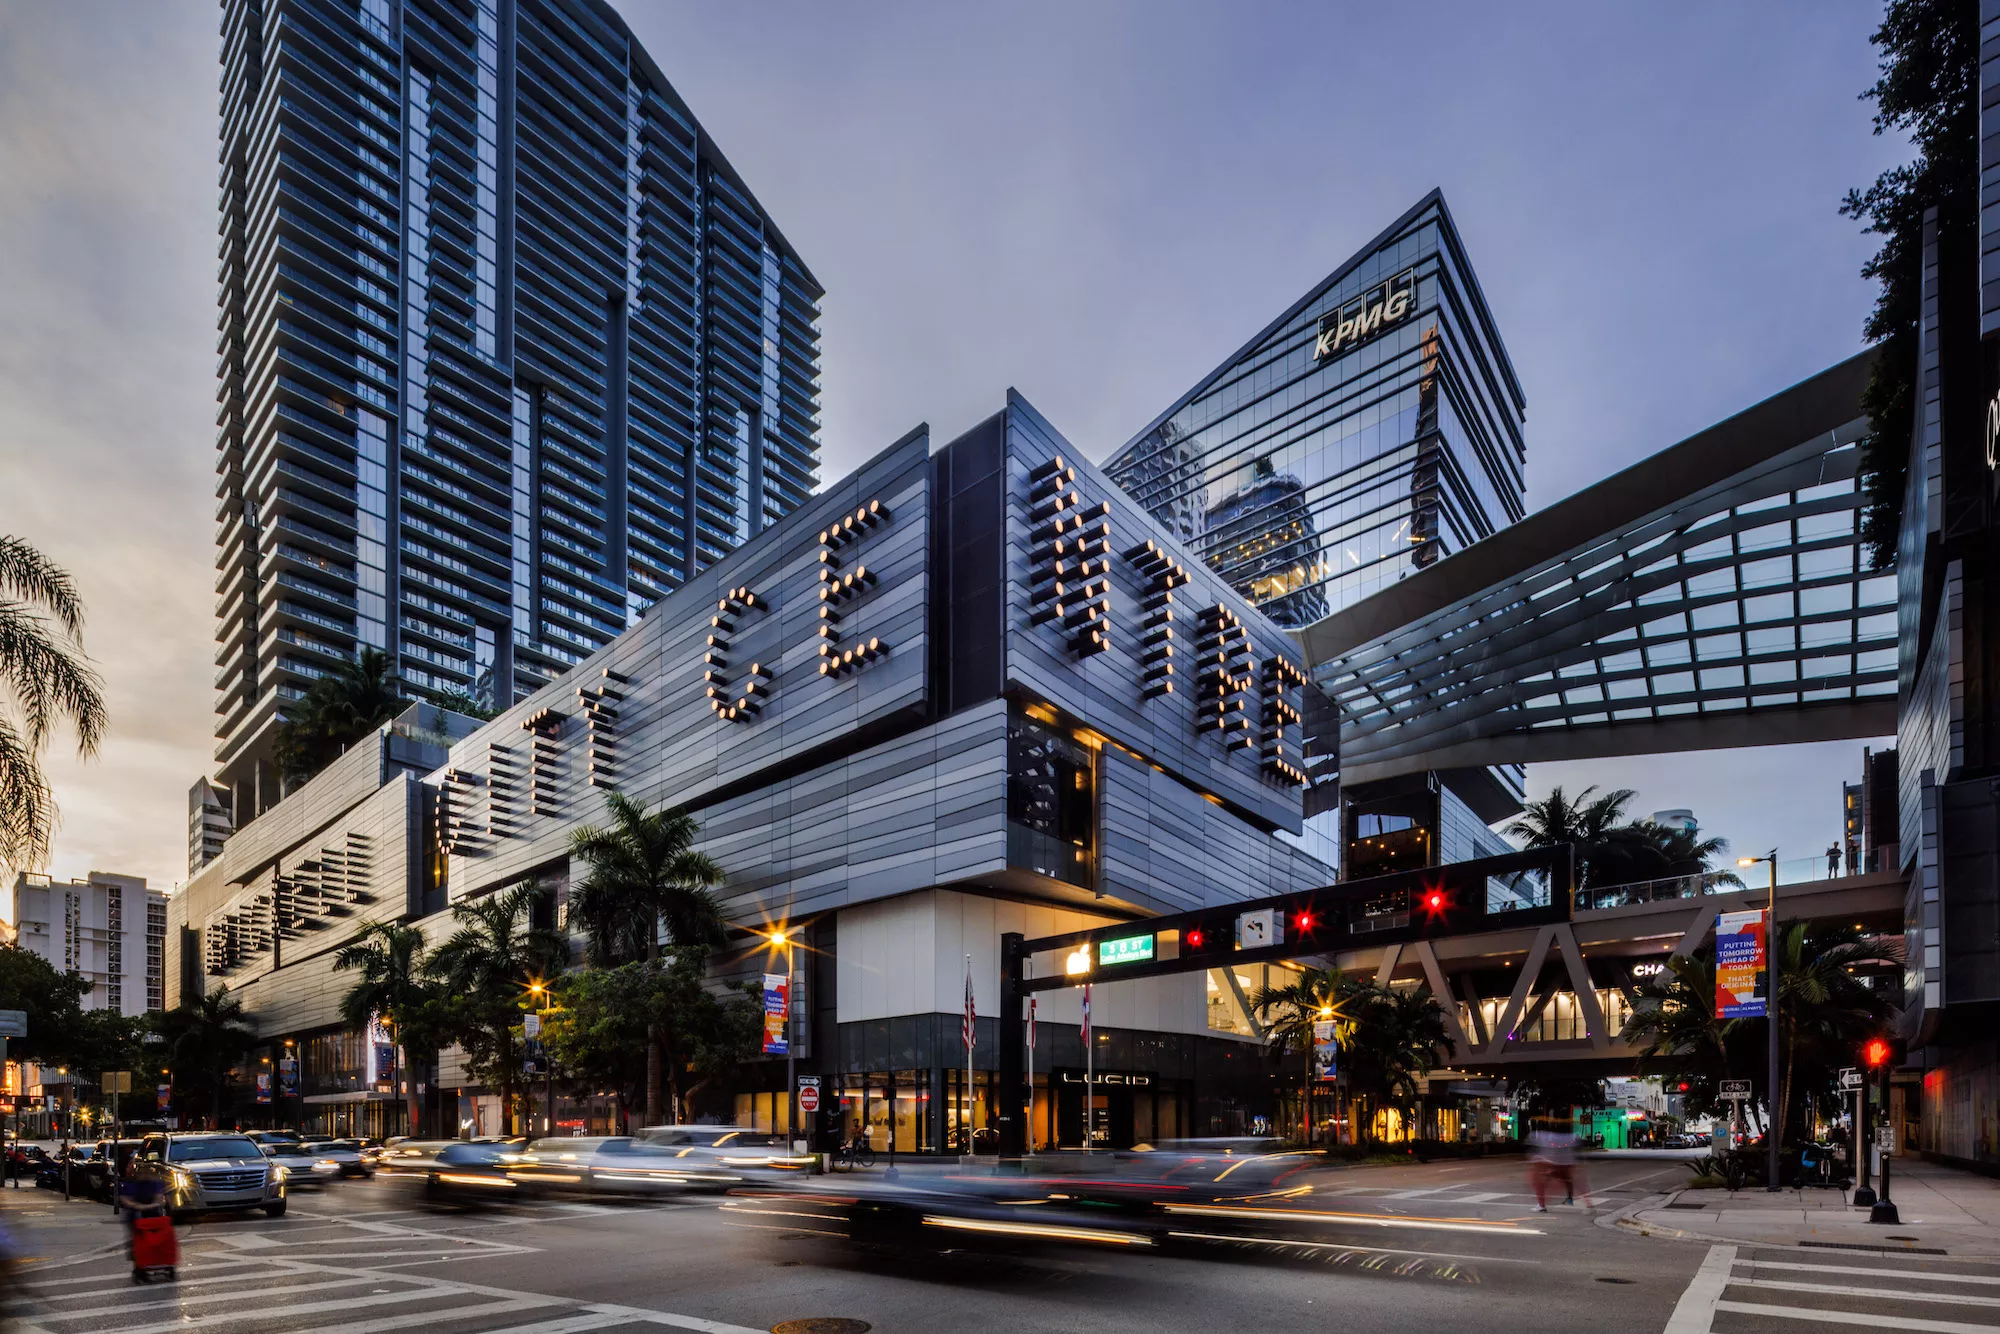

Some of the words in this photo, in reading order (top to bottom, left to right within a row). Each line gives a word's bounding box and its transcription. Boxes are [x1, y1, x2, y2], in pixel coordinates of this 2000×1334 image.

[1312, 288, 1410, 361] KPMG
[434, 667, 629, 856] CITY
[1109, 944, 1115, 954] S
[1131, 939, 1144, 950] ST
[1724, 940, 1758, 949] PUTTING
[1718, 947, 1764, 957] TOMORROW
[1721, 955, 1748, 965] AHEAD
[1749, 955, 1760, 963] OF
[1727, 964, 1754, 972] TODAY.
[1727, 974, 1753, 982] THAT'S
[1720, 980, 1761, 989] ORIGINAL.
[1062, 1072, 1151, 1085] LUCID
